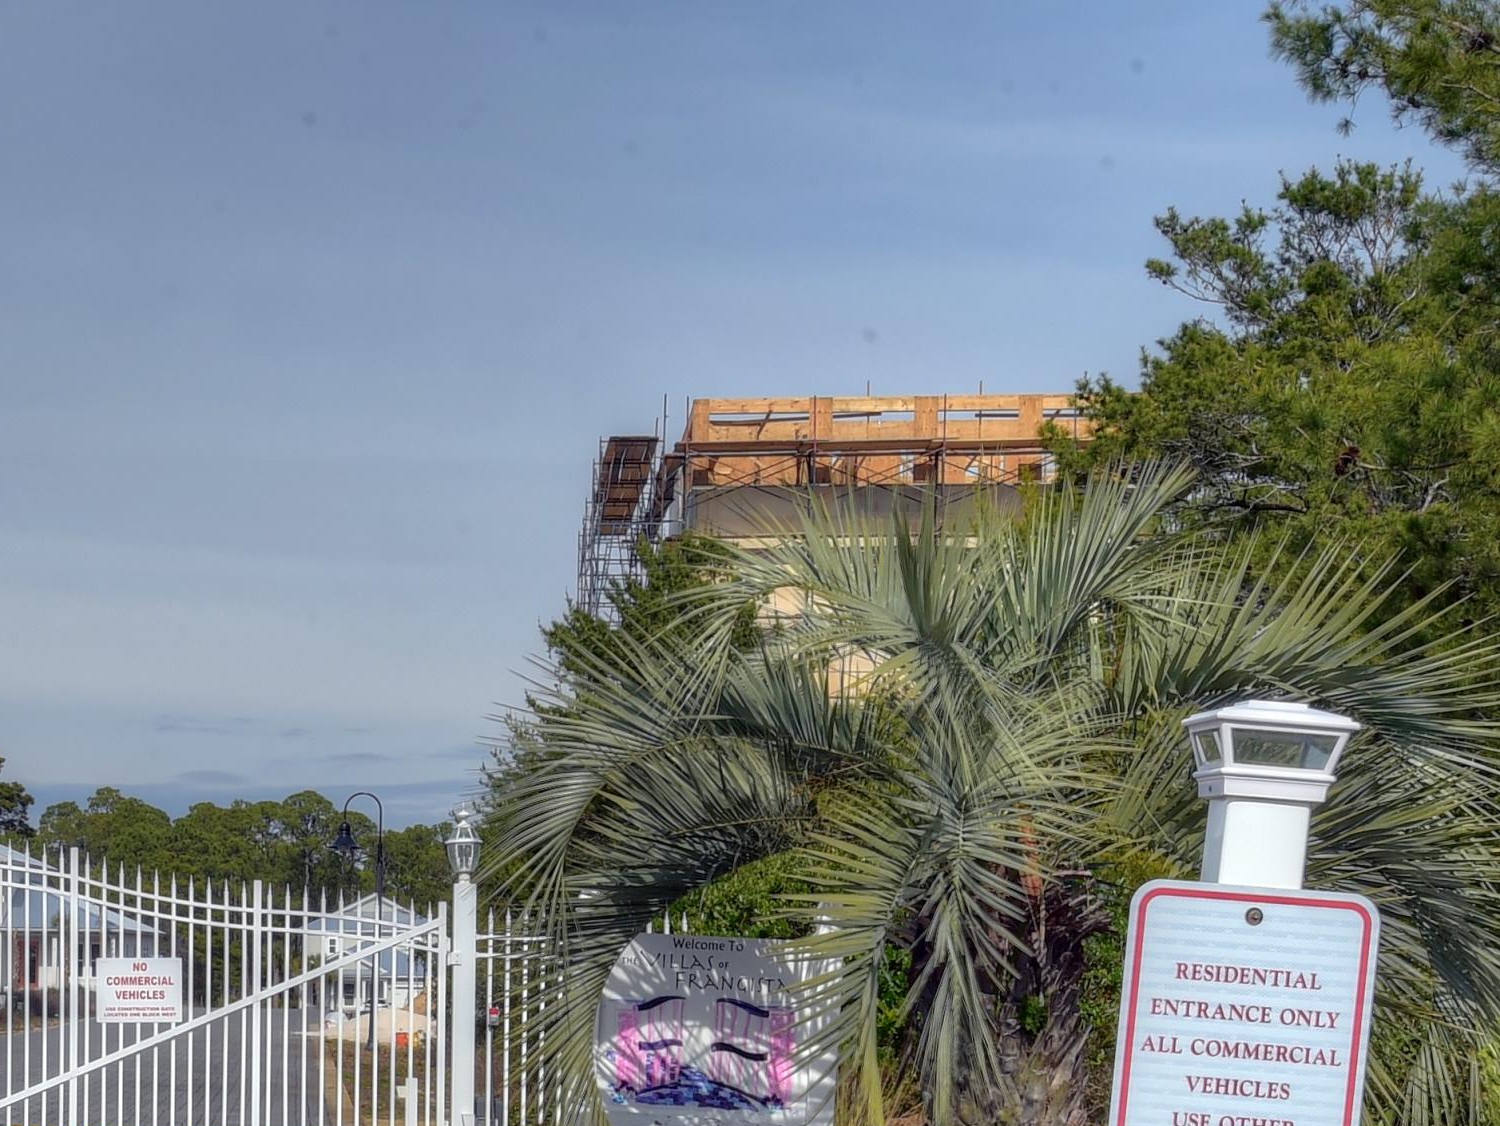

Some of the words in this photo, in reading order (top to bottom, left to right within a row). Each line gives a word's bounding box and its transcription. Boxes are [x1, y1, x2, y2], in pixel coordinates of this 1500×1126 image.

[672, 937, 726, 951] Welcome
[729, 940, 744, 952] To
[132, 962, 148, 972] NO
[640, 950, 714, 971] VILLAS
[106, 976, 174, 986] COMMERCIAL
[1175, 962, 1322, 990] RESIDENTIAL
[115, 990, 165, 1000] VEHICLES
[1150, 998, 1272, 1024] ENTRANCE
[1279, 1008, 1341, 1029] ONLY
[1140, 1035, 1183, 1055] ALL
[1190, 1038, 1342, 1067] COMMERCIAL
[1185, 1075, 1291, 1100] VEHICLES
